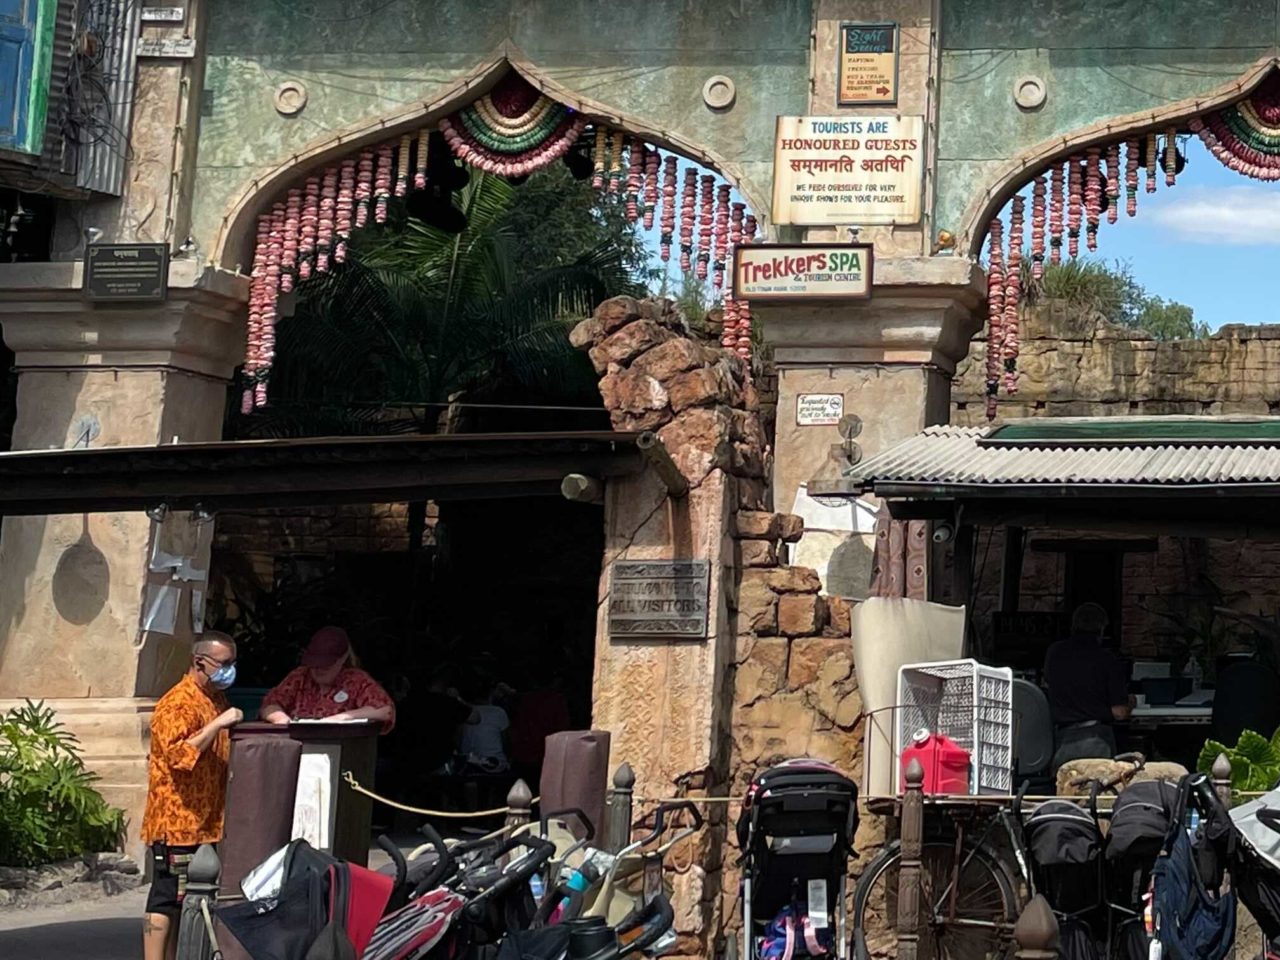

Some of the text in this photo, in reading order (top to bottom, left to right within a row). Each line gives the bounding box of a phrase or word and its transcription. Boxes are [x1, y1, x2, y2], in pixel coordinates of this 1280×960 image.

[811, 121, 889, 134] TOURISTS ARE
[781, 139, 917, 151] HONOURED GUESTS
[741, 252, 861, 284] Trekkers SPA
[639, 599, 702, 613] VISITORS
